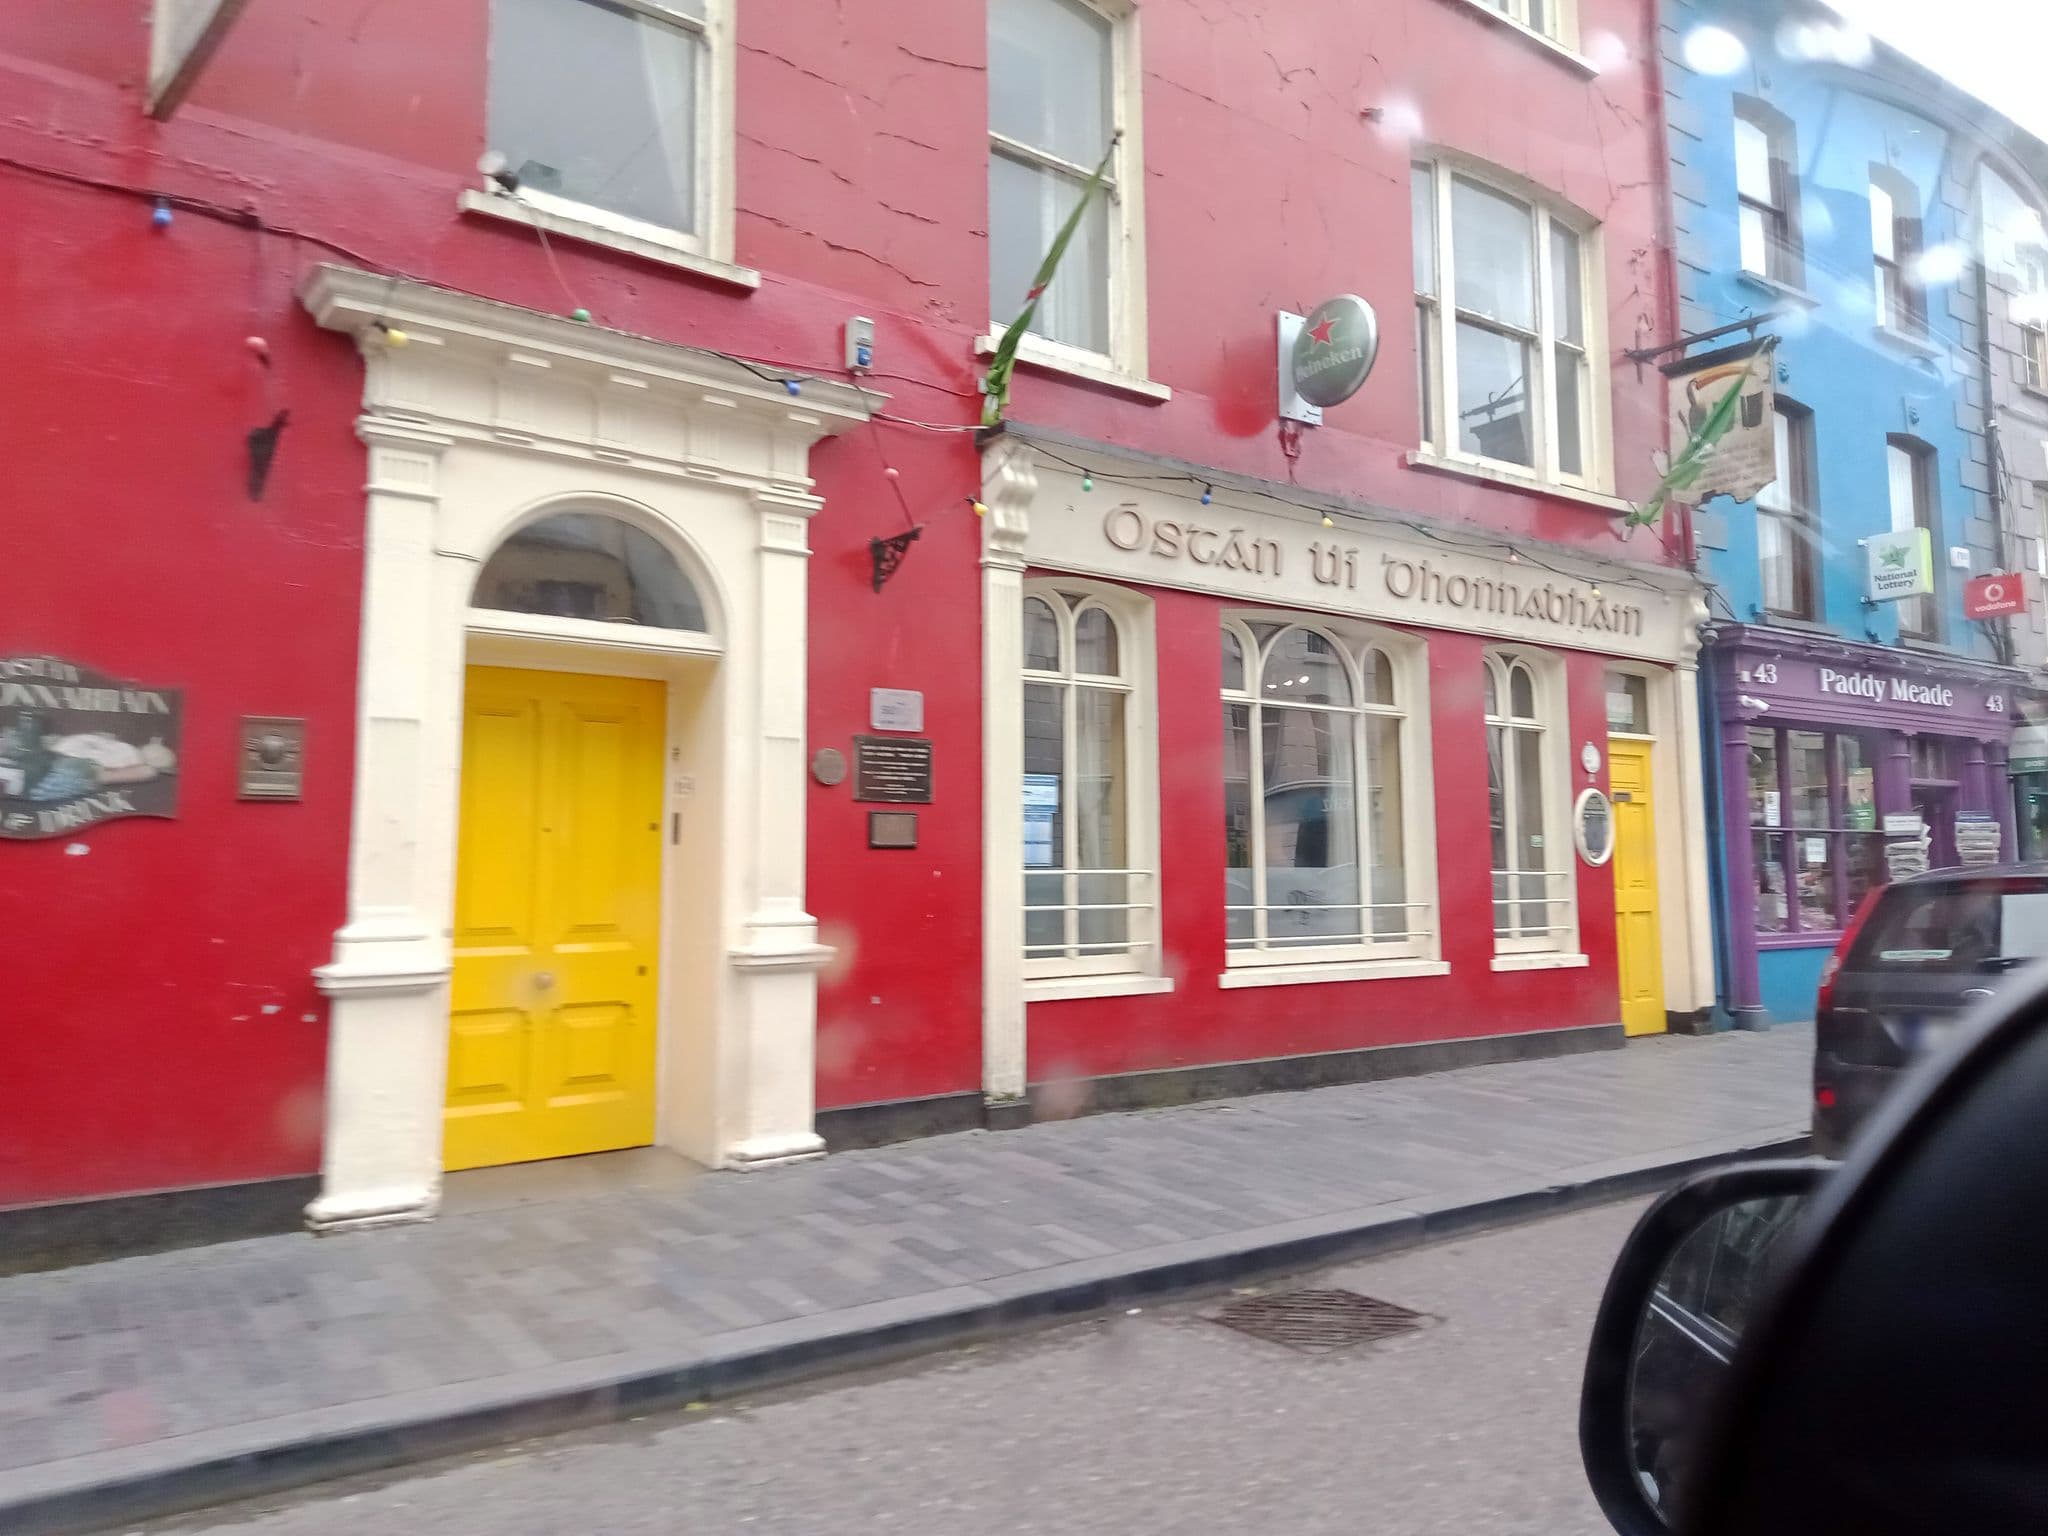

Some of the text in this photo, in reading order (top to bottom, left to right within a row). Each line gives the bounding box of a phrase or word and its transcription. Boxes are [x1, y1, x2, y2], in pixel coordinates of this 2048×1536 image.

[1874, 568, 1918, 582] National
[1877, 579, 1915, 591] Lottery
[1973, 600, 2017, 613] vodafone
[1752, 662, 2004, 713] 43 Paddy Meade 43
